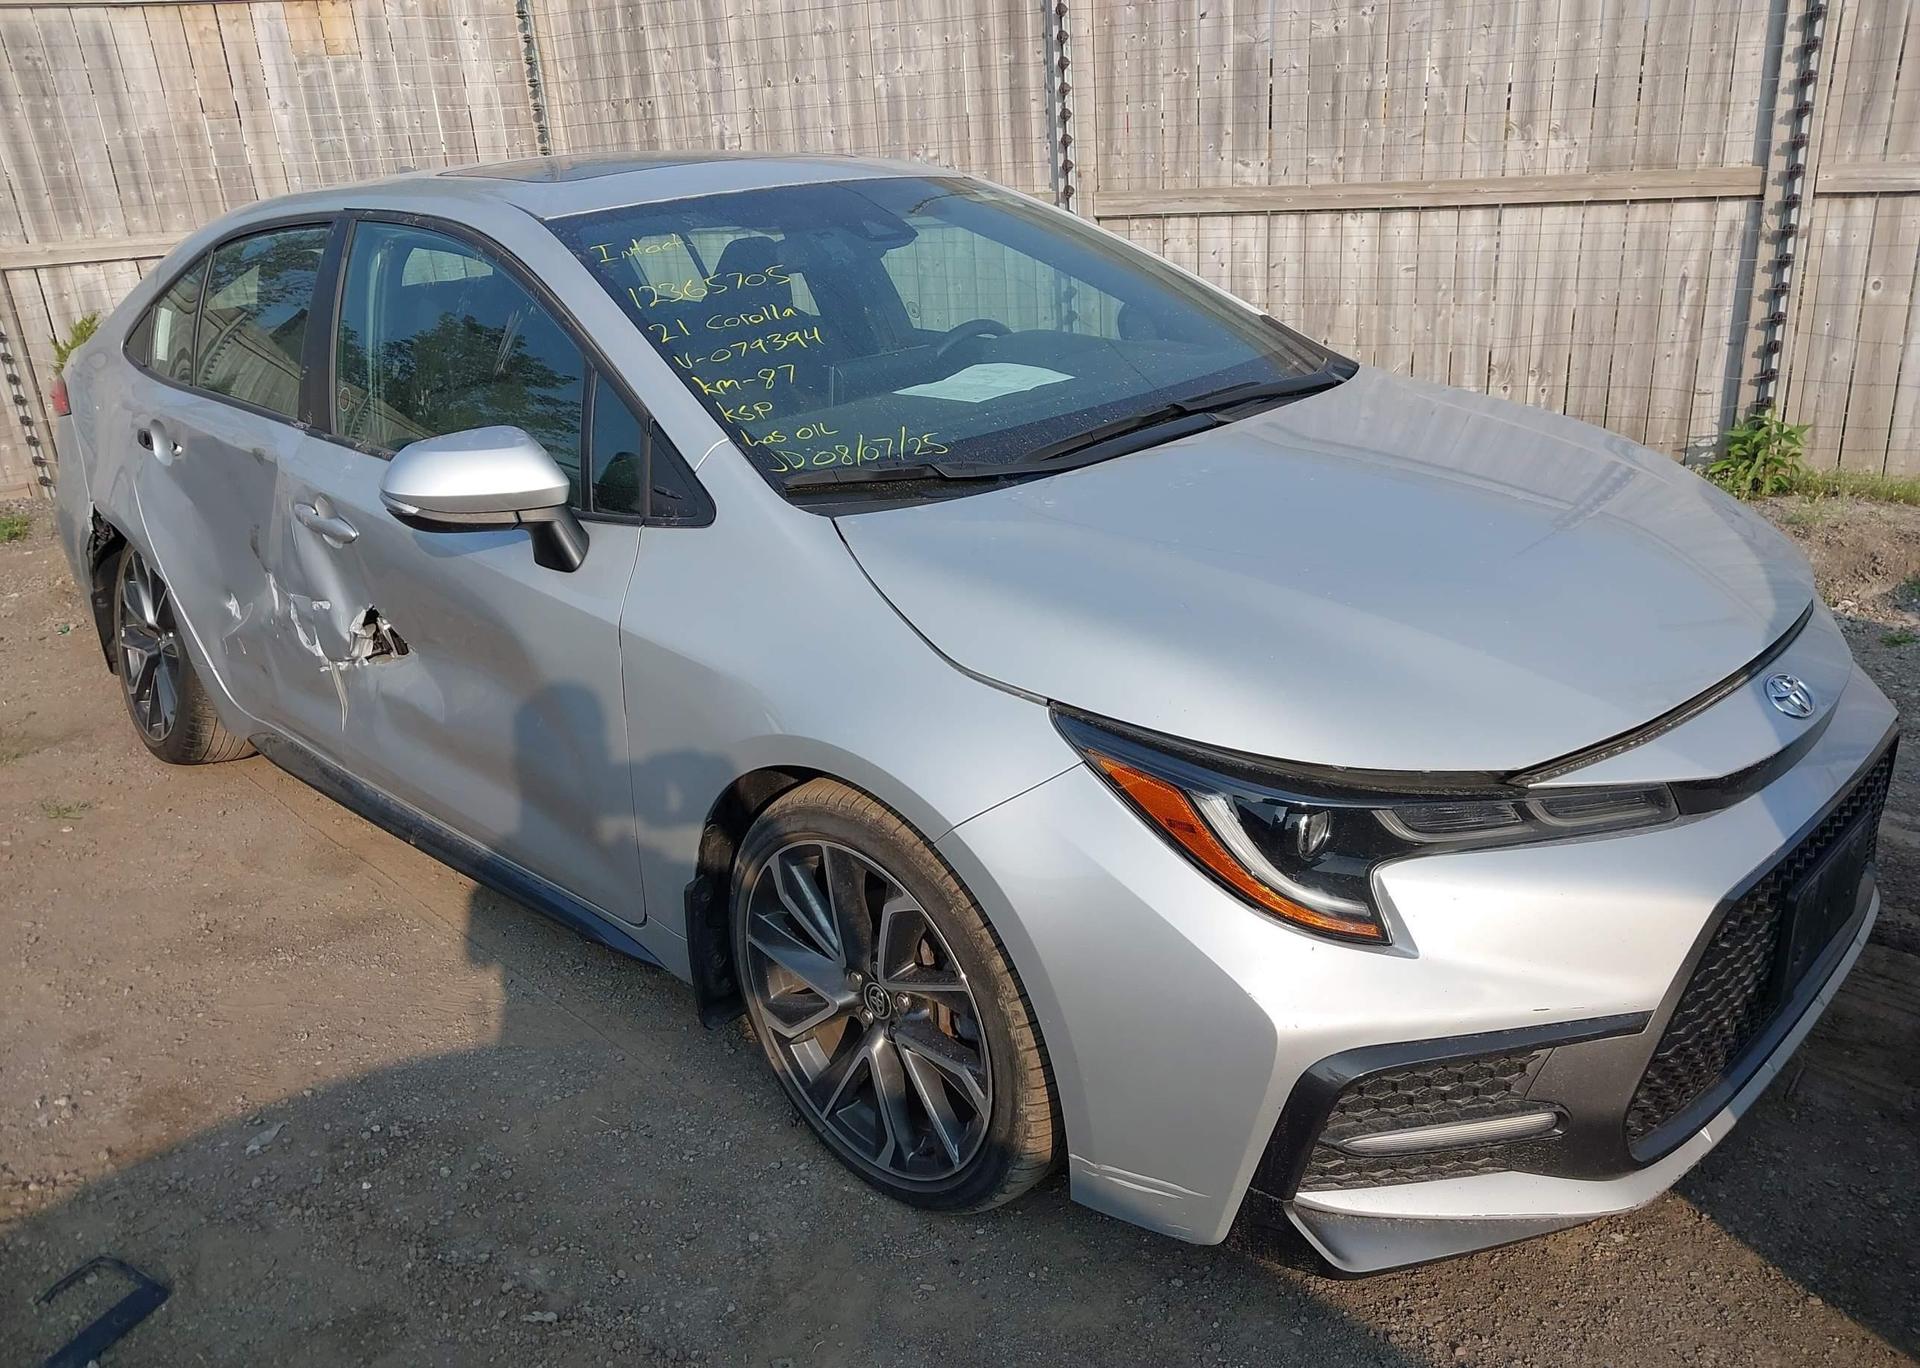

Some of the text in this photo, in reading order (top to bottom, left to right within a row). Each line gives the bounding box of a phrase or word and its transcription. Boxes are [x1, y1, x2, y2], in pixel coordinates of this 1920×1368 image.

[628, 264, 791, 310] 12365705
[648, 319, 692, 343] 21
[812, 426, 949, 467] 08/07/25
